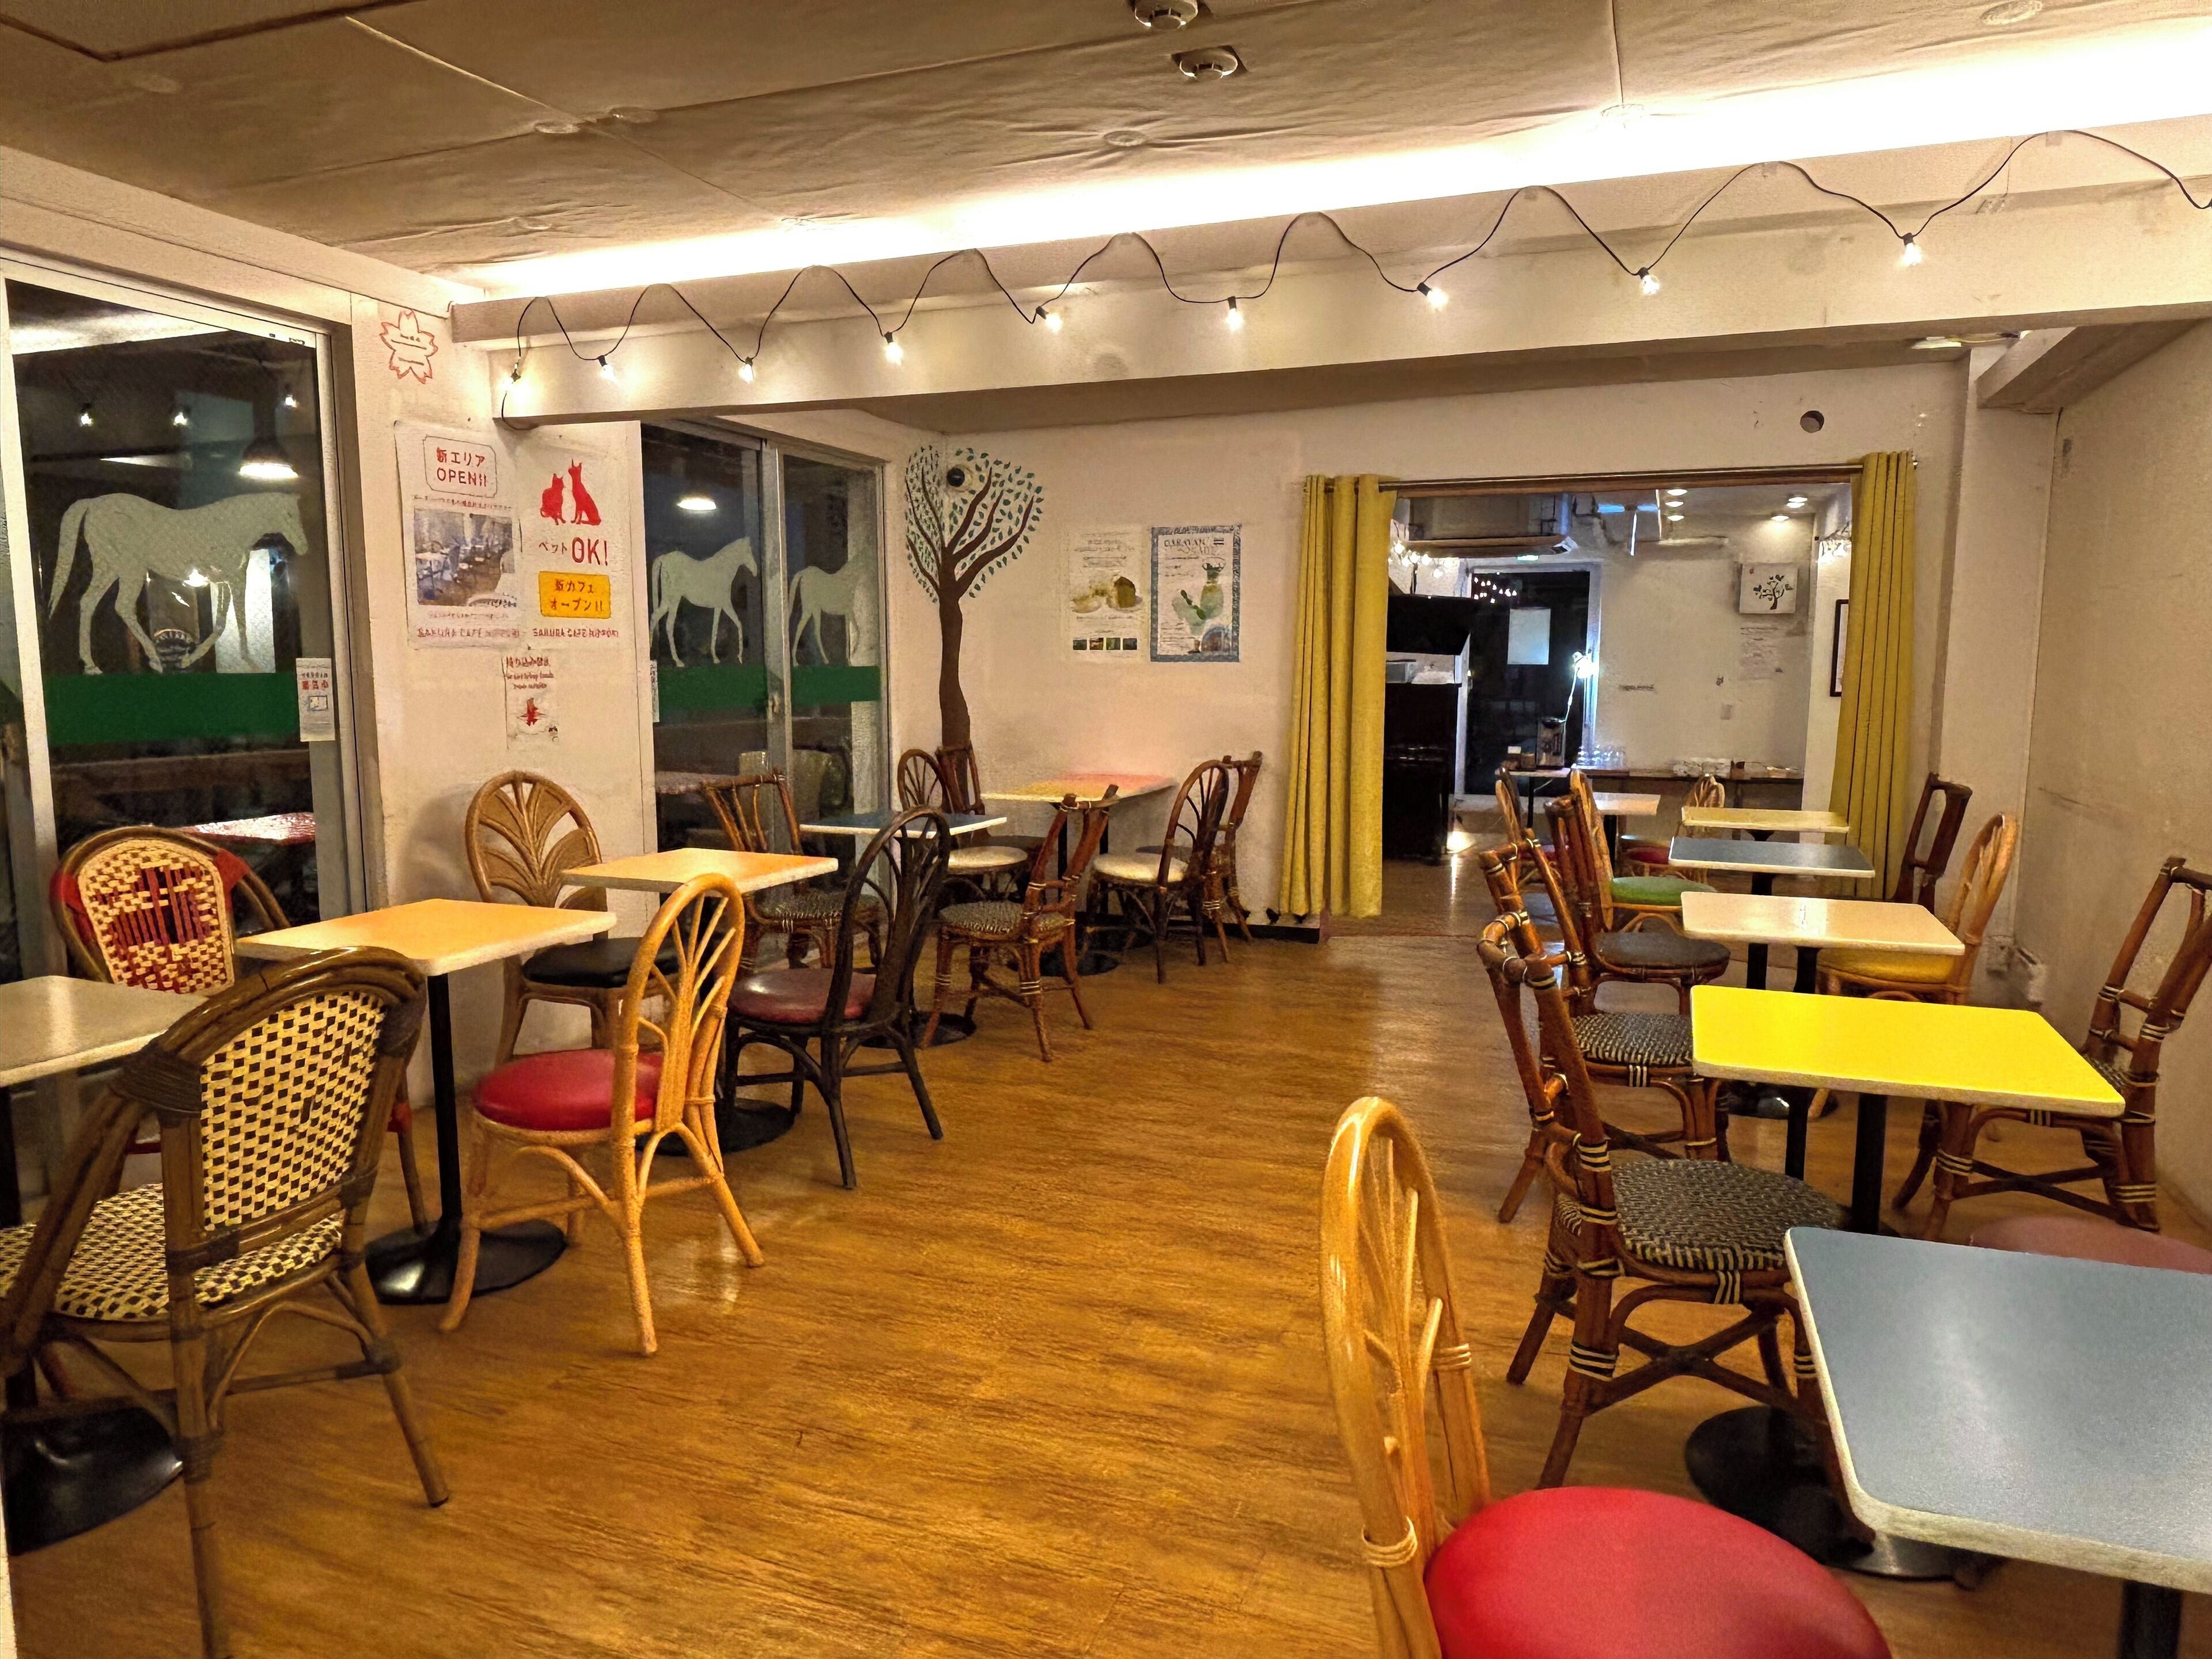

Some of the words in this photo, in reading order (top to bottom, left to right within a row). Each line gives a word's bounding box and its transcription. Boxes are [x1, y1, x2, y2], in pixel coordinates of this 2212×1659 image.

[436, 447, 485, 467] 新エリア
[437, 467, 486, 487] OPEN!!
[571, 536, 608, 566] OK!
